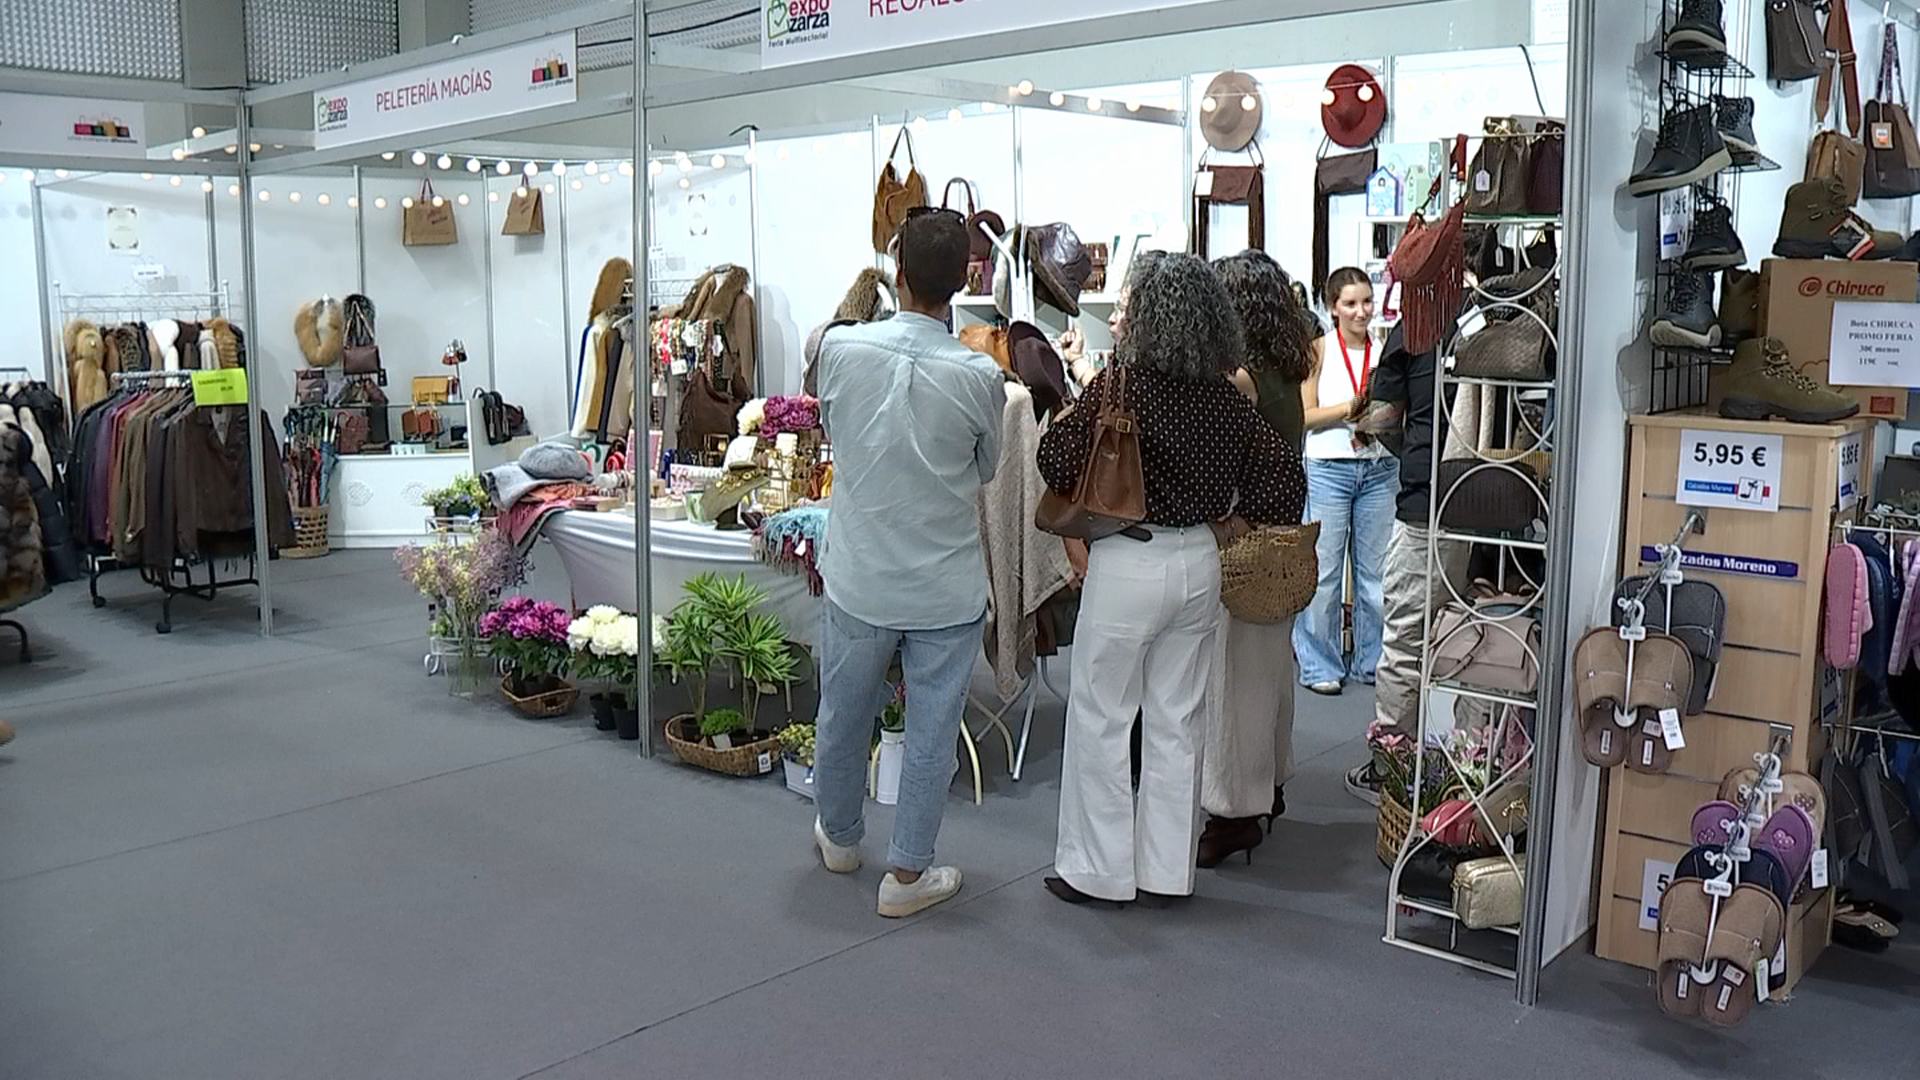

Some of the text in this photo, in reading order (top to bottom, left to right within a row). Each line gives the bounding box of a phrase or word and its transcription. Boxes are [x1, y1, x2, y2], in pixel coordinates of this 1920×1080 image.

[789, 0, 830, 16] expo
[789, 12, 830, 33] zarza
[376, 77, 438, 112] PELETERÍA
[441, 67, 492, 99] MACÍAS
[1826, 280, 1886, 296] Chiruca
[1850, 319, 1914, 329] Bota CHIRUCA
[1848, 332, 1914, 341] PROMO FERIA
[1694, 442, 1767, 467] 5,95 €
[1723, 557, 1777, 574] Moreno
